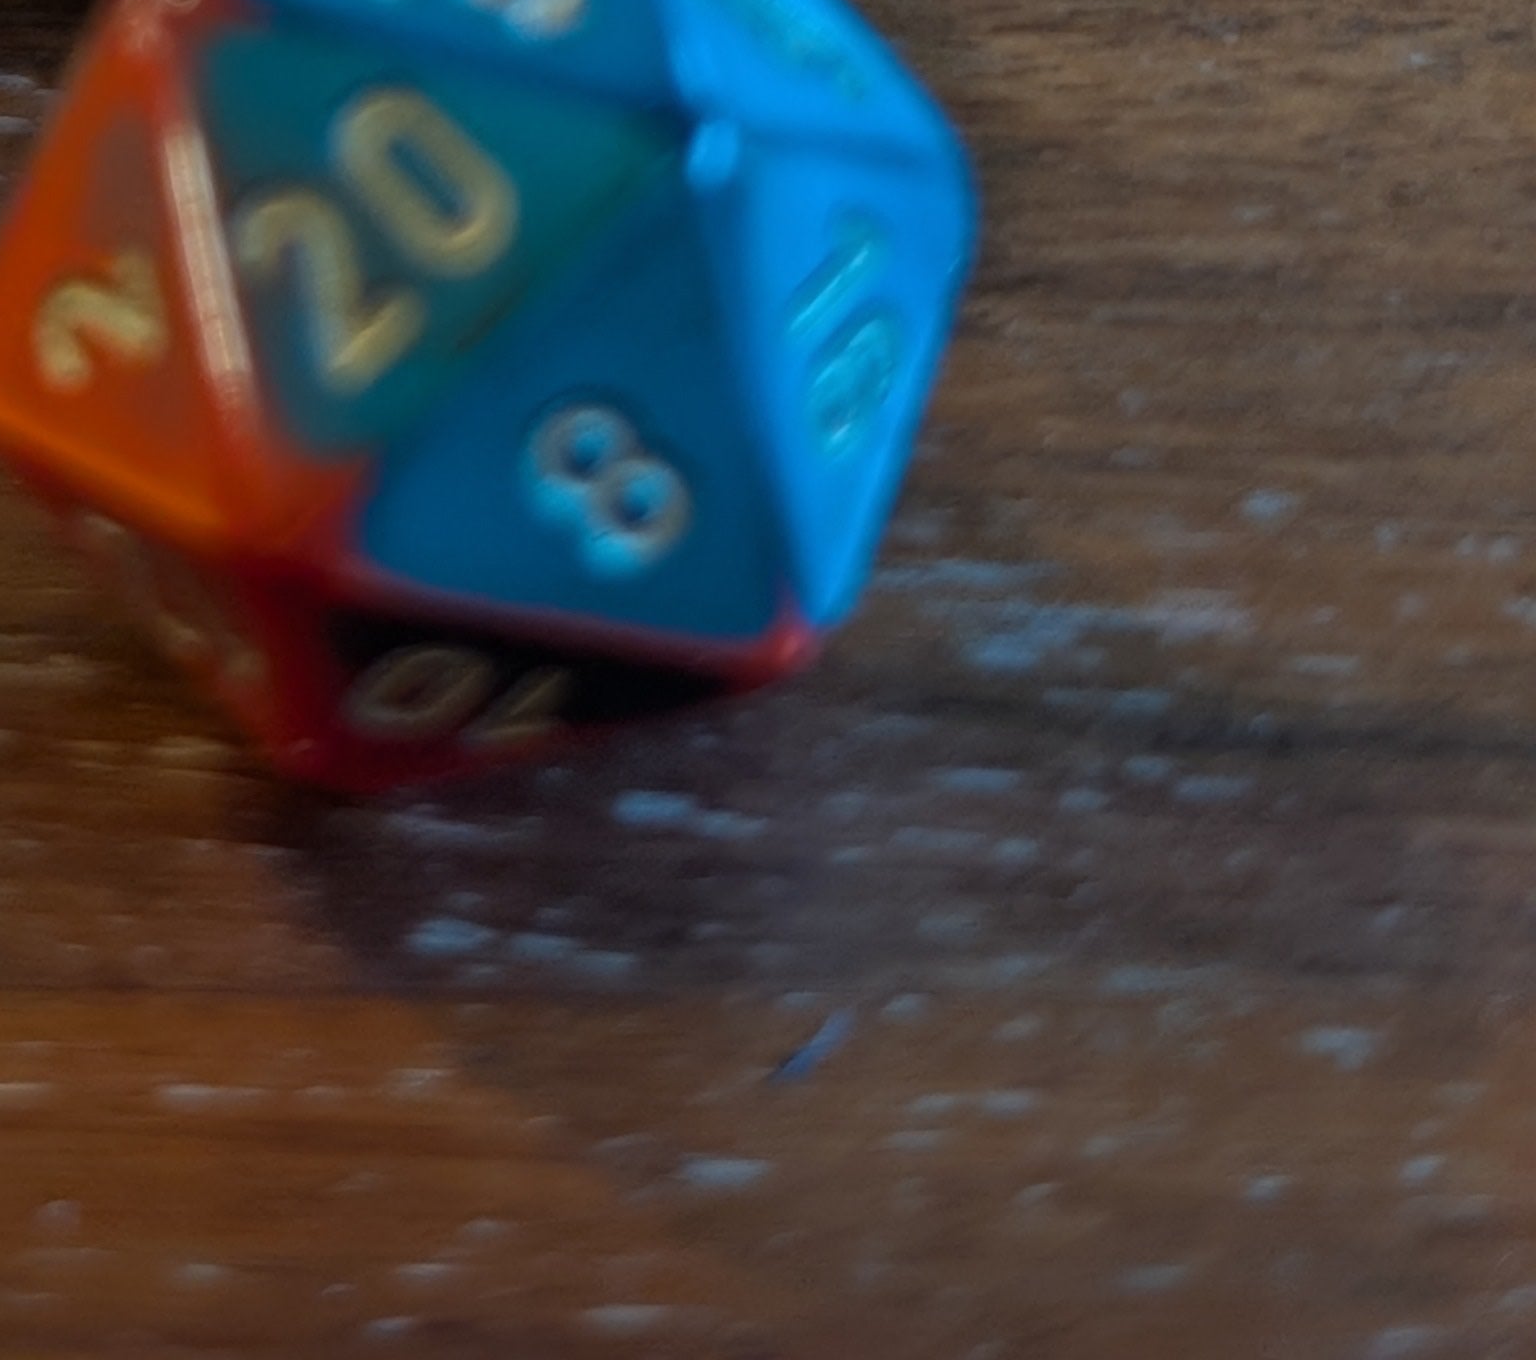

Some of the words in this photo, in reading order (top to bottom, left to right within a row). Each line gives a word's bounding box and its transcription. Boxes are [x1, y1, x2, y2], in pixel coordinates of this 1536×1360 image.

[35, 245, 170, 394] 2
[237, 85, 521, 399] 20
[526, 398, 695, 580] 8
